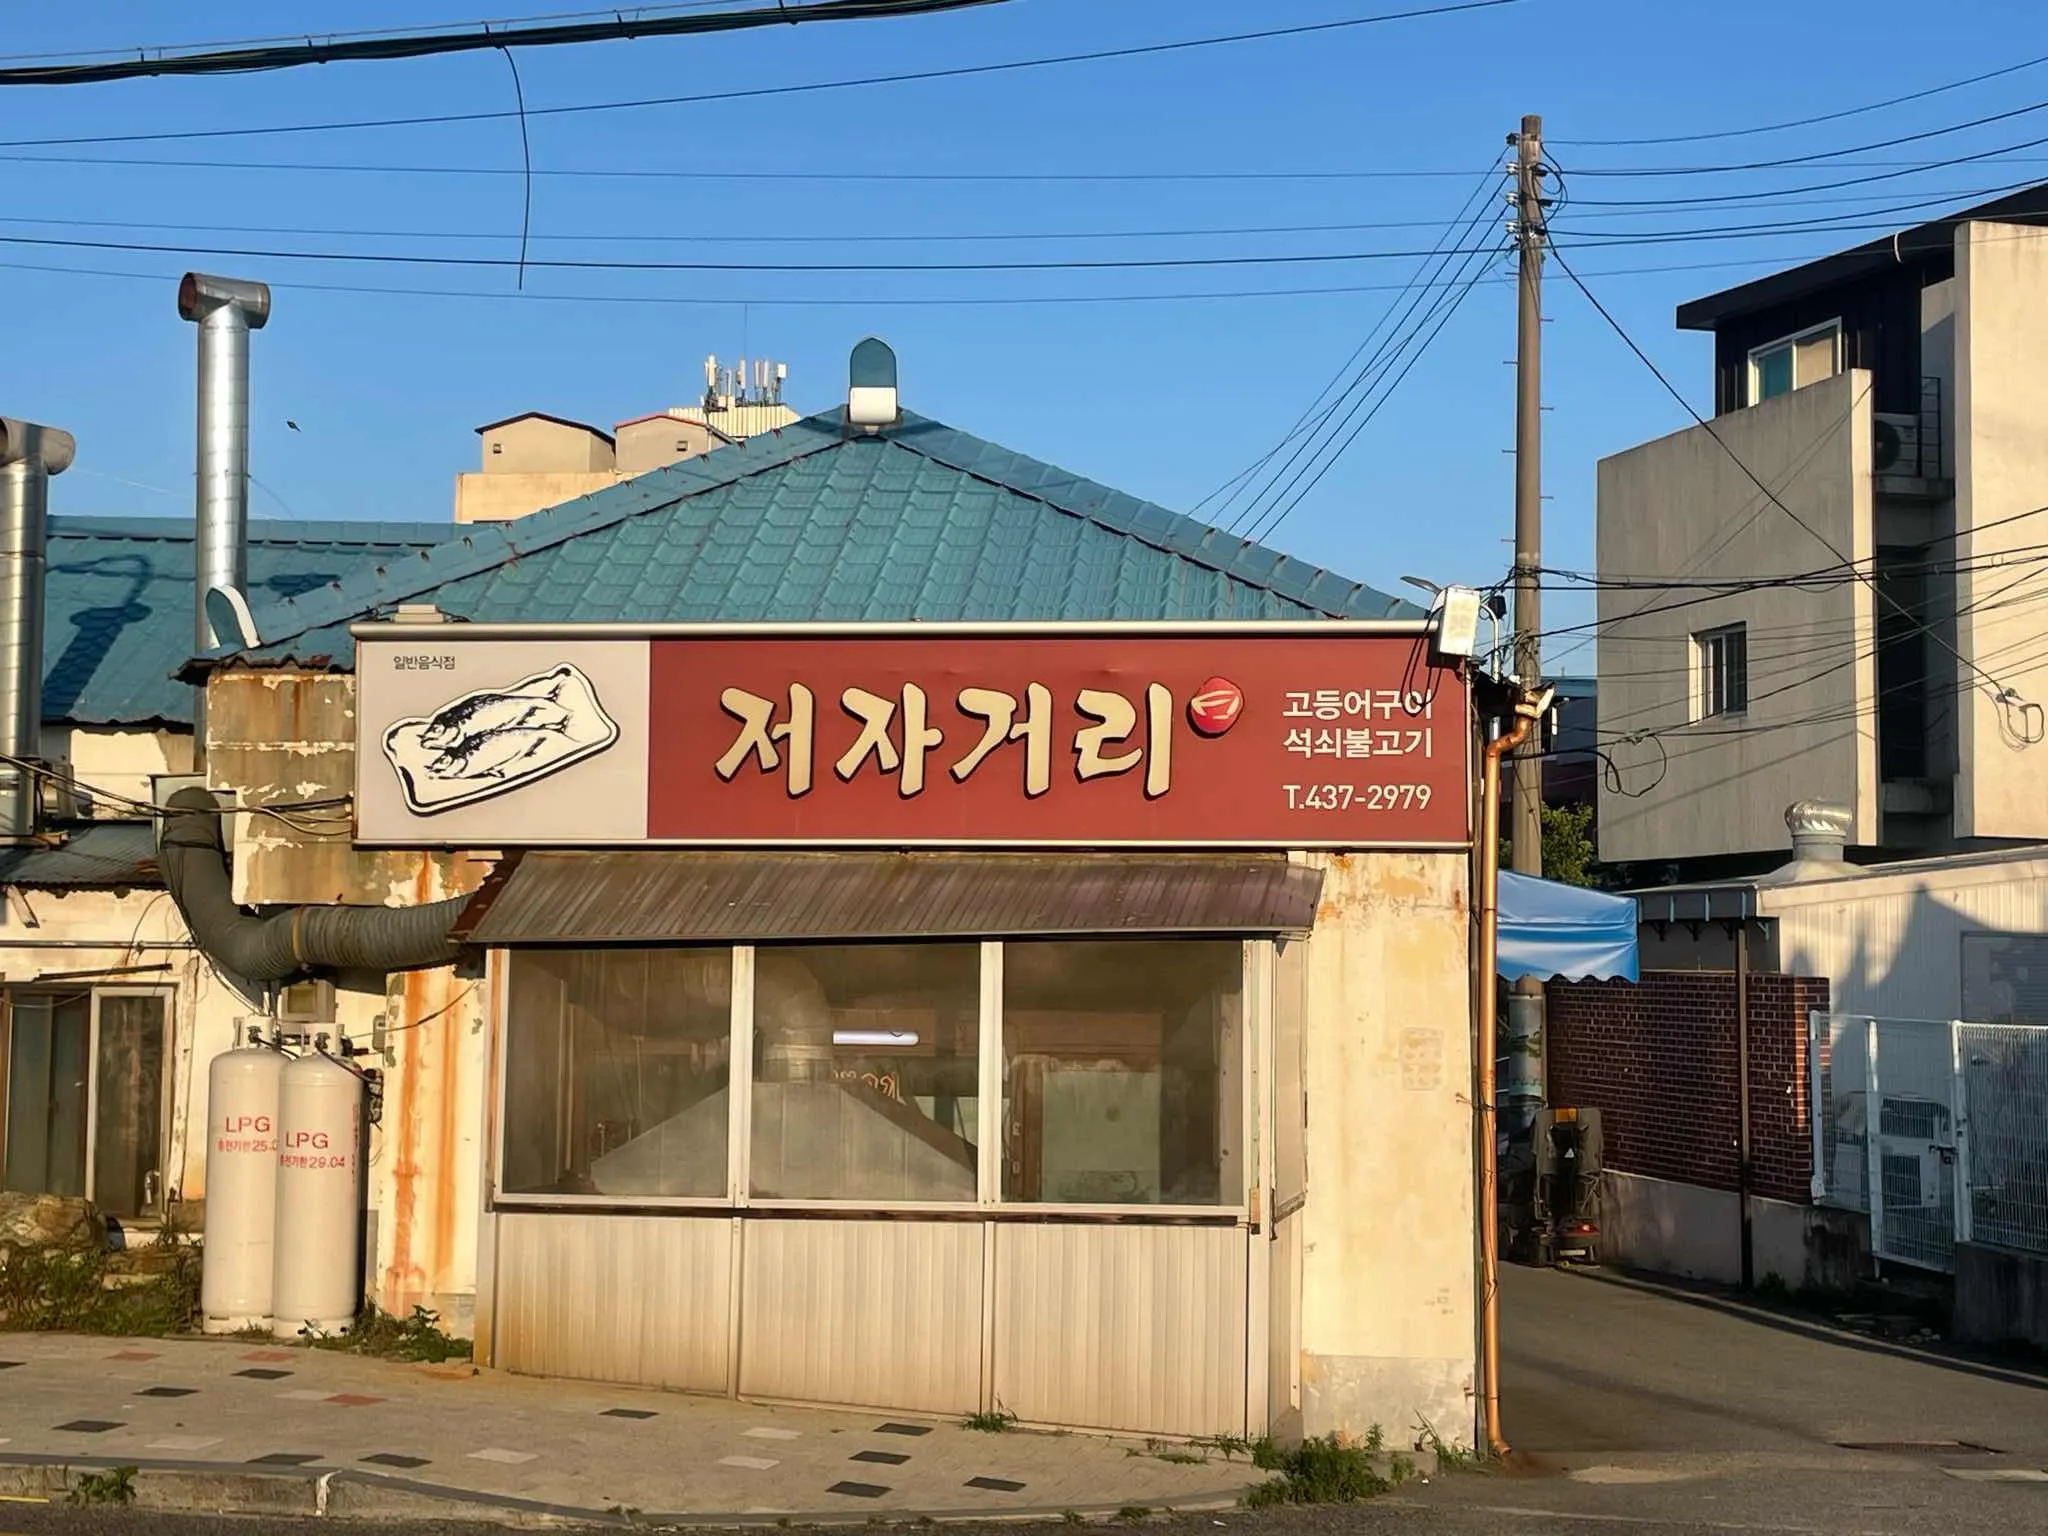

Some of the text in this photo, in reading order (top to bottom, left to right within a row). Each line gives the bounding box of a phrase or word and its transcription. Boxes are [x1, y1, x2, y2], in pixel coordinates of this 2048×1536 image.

[392, 655, 456, 671] 일반음식점
[1282, 688, 1433, 721] 고등어구이
[715, 681, 1172, 798] 저자거리
[1283, 727, 1433, 759] 석쇠불고기
[1282, 784, 1432, 811] T.437-2979
[225, 1116, 271, 1133] LPG
[285, 1131, 329, 1149] LPG
